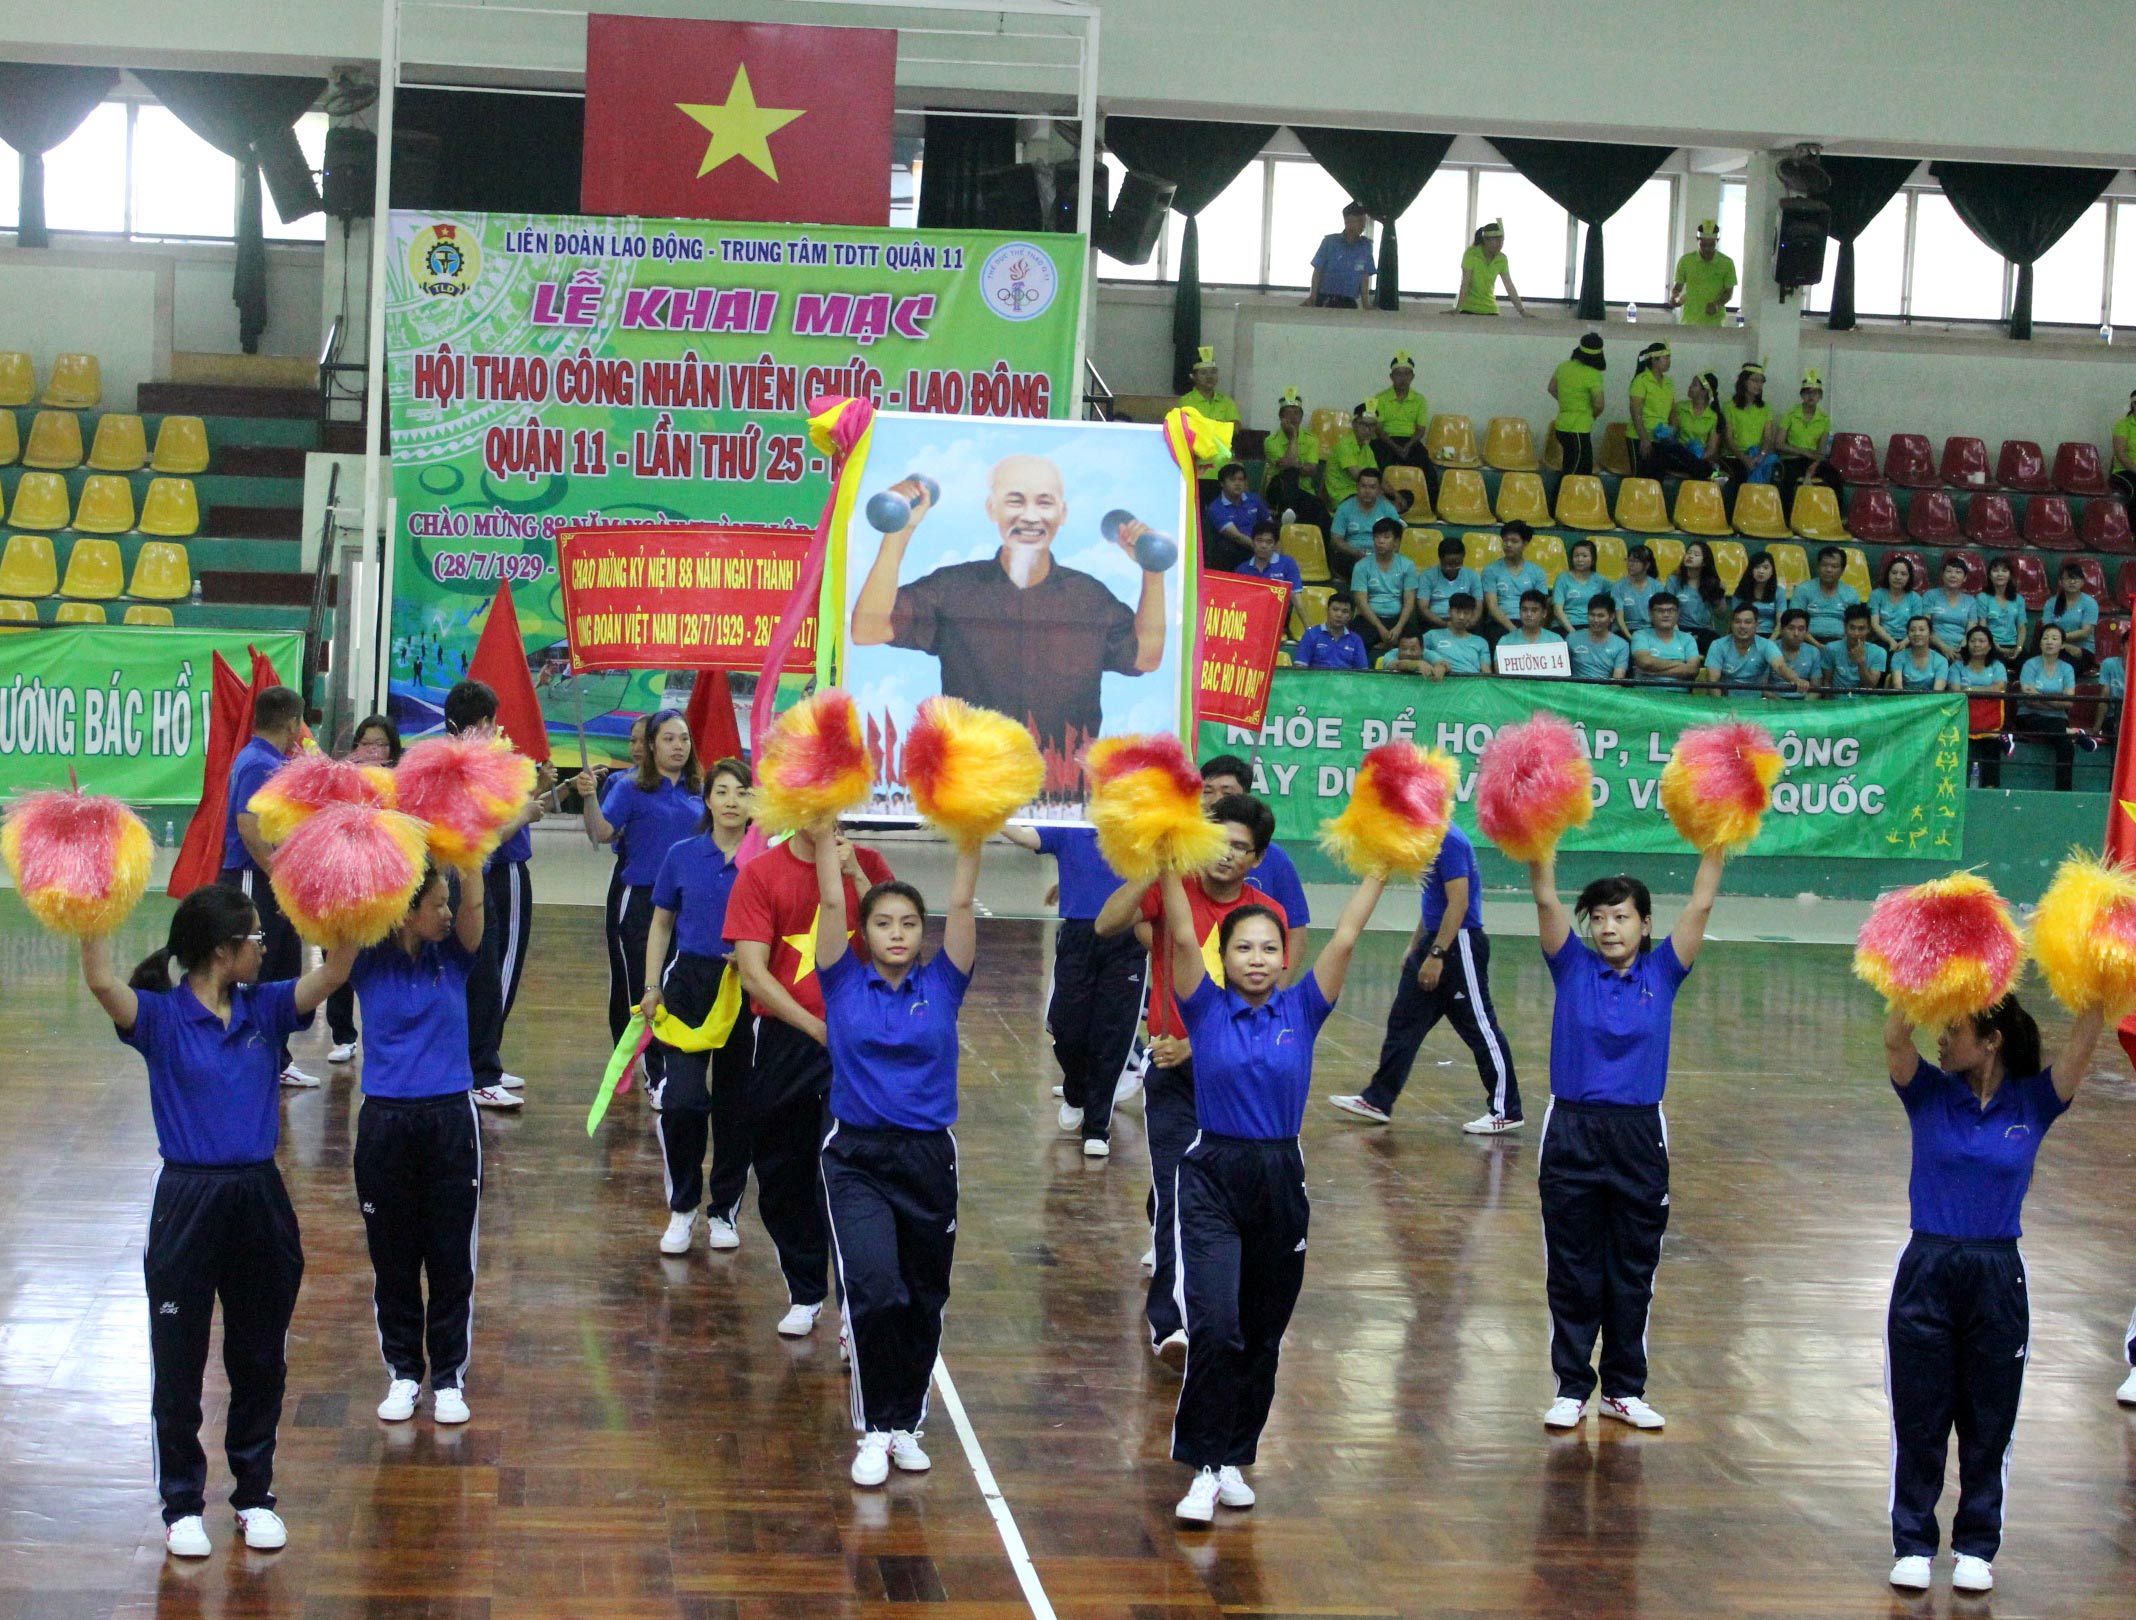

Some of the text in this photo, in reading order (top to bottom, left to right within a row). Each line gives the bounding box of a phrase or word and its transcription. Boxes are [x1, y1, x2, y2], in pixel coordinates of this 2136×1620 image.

[506, 227, 548, 253] LIÊN
[554, 229, 605, 256] ĐOÀN
[611, 236, 647, 258] LAO
[652, 233, 703, 262] ĐỘNG
[721, 240, 782, 263] TRUNG
[788, 237, 828, 264] TÂM
[834, 243, 880, 266] TDTT
[886, 242, 936, 271] QUẬN
[943, 248, 964, 270] 11
[533, 270, 936, 343] LỄ KHAI MẠC
[415, 342, 465, 408] HỘI
[473, 355, 548, 402] THAO
[556, 347, 634, 406] CÔNG
[642, 351, 721, 408] NHÂN
[729, 353, 796, 411] VIÊN
[804, 356, 882, 411] CHỨC
[909, 370, 964, 414] LAO
[486, 416, 563, 481] QUẬN
[573, 430, 607, 475] 11
[636, 413, 693, 477] LẦN
[700, 424, 761, 480] THỨ
[766, 437, 804, 481] 25
[408, 506, 469, 536] CHÀO
[472, 505, 538, 538] MỪNG
[434, 551, 543, 581] (28/7/1929
[571, 550, 596, 590] CHÀO
[597, 549, 627, 588] MỪNG
[630, 545, 646, 588] KỶ
[648, 549, 676, 594] NIỆM
[679, 557, 693, 588] 88
[696, 551, 721, 588] NĂM
[724, 550, 754, 589] NGÀY
[756, 550, 794, 590] THÀNH
[593, 605, 622, 646] ĐOÀN
[624, 605, 649, 650] VIỆT
[652, 613, 677, 645] NAM
[680, 614, 744, 648] (28/7/1929
[1220, 602, 1247, 645] ĐỘNG
[1201, 653, 1221, 692] BÁC
[1220, 651, 1238, 694] HỒ
[1551, 654, 1564, 669] 14
[84, 670, 143, 756] BÁC
[152, 660, 192, 757] HỒ
[1226, 705, 1343, 749] KHỎE
[1360, 706, 1417, 750] ĐỂ
[1776, 729, 1861, 776] ỘNG
[1250, 757, 1301, 796] ÂY
[1771, 774, 1886, 816] QUỐC
